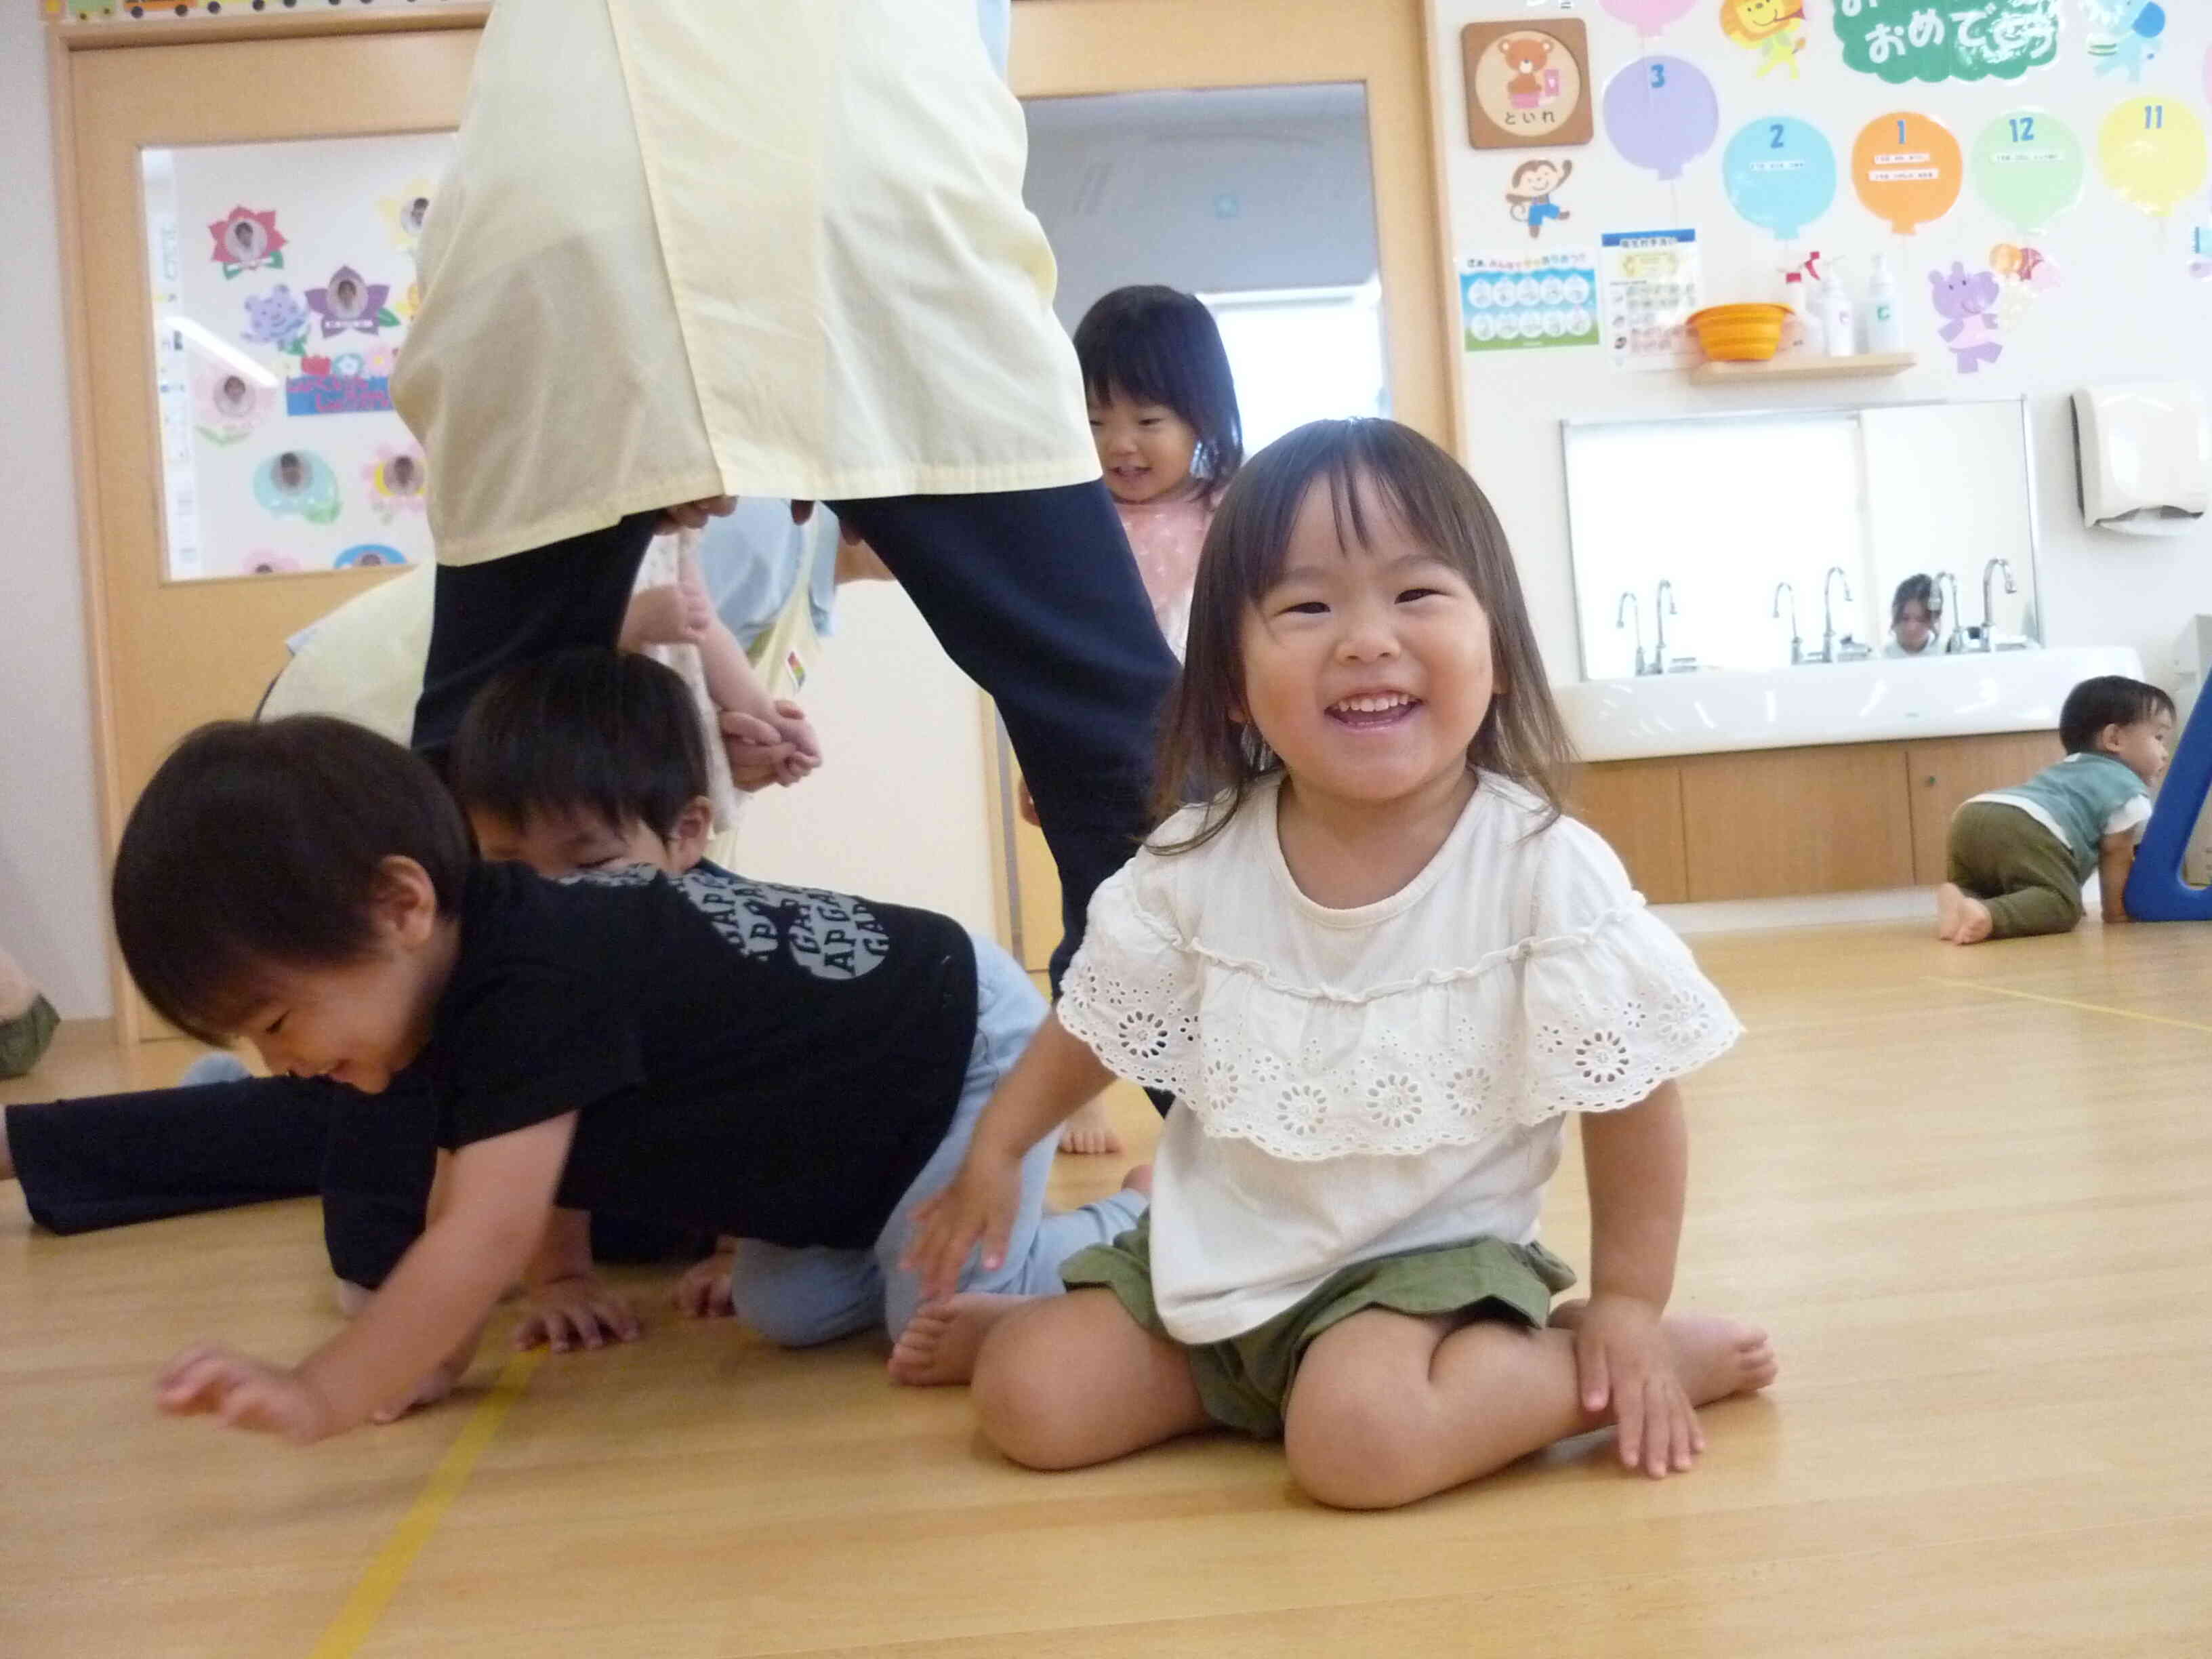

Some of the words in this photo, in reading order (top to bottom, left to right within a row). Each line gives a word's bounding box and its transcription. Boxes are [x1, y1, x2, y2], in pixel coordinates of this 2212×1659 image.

[1651, 64, 1665, 88] 3
[1504, 111, 1555, 125] といれ
[2144, 104, 2163, 129] 11
[1769, 124, 1784, 149] 2
[1897, 120, 1905, 145] 1
[2009, 117, 2034, 142] 12
